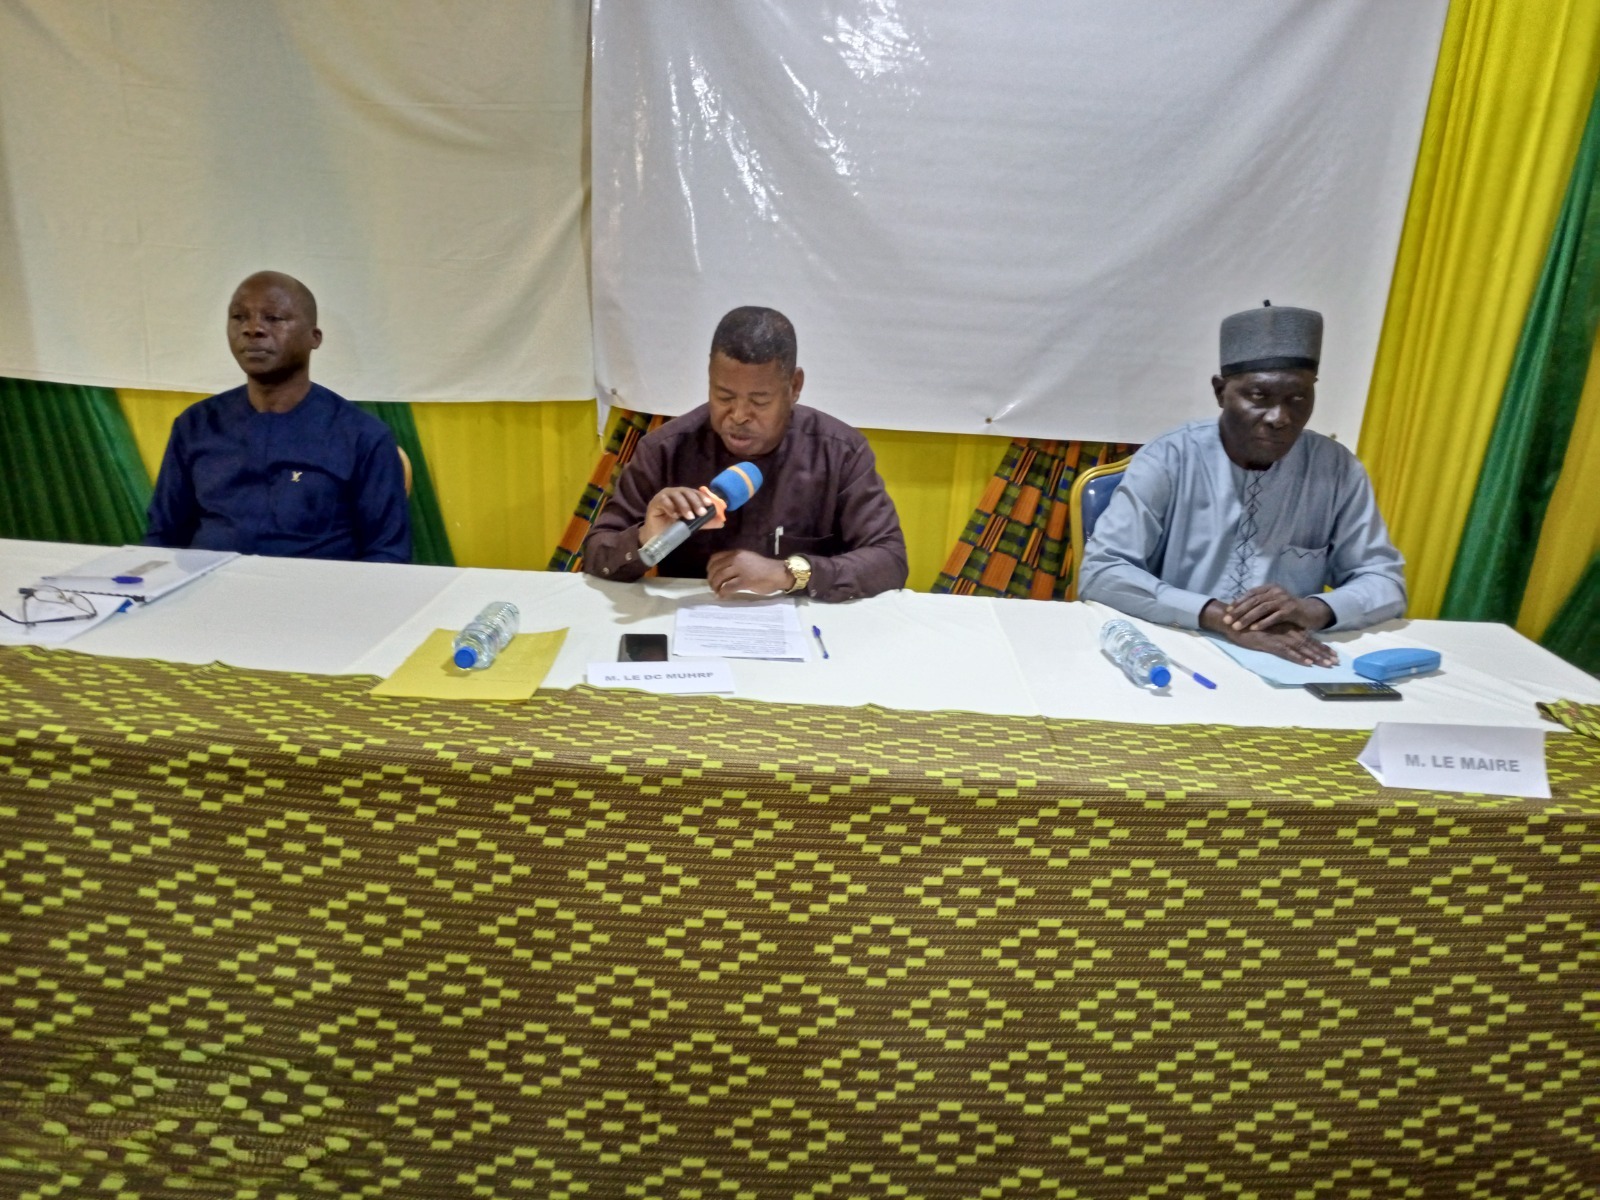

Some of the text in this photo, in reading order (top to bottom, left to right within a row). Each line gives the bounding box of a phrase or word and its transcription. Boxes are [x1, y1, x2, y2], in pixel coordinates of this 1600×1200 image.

[605, 674, 620, 682] M.
[1404, 753, 1521, 773] M. LE MAIRE
